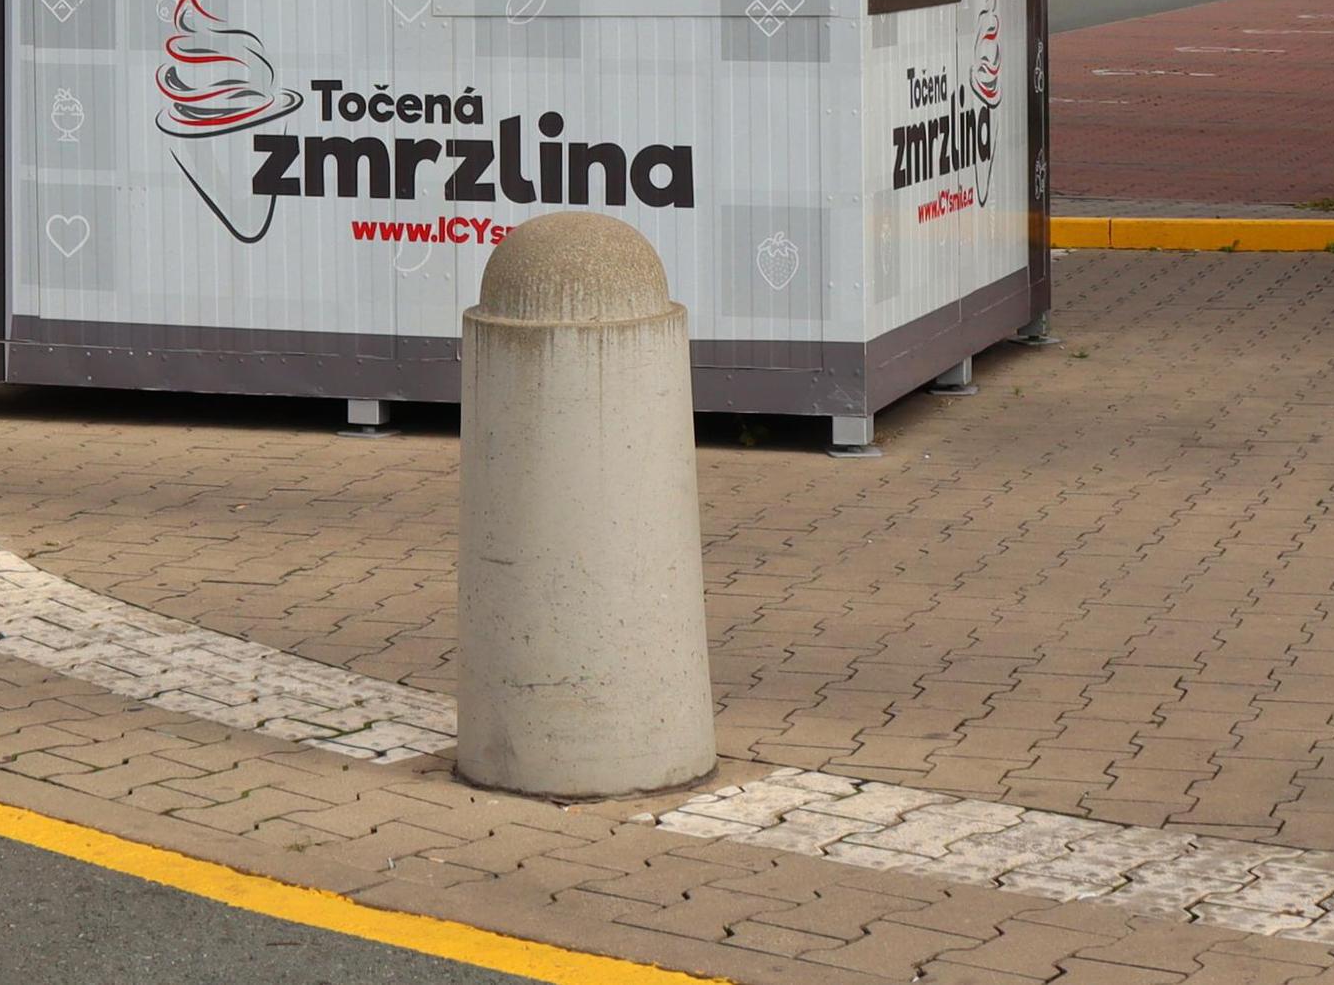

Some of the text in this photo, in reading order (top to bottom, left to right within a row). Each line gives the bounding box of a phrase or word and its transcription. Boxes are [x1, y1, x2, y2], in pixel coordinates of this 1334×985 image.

[310, 79, 485, 125] Točená
[907, 66, 948, 110] Točená
[251, 110, 695, 208] zmrzlina
[893, 84, 991, 191] zmrzlina
[351, 216, 517, 245] www.ICYs
